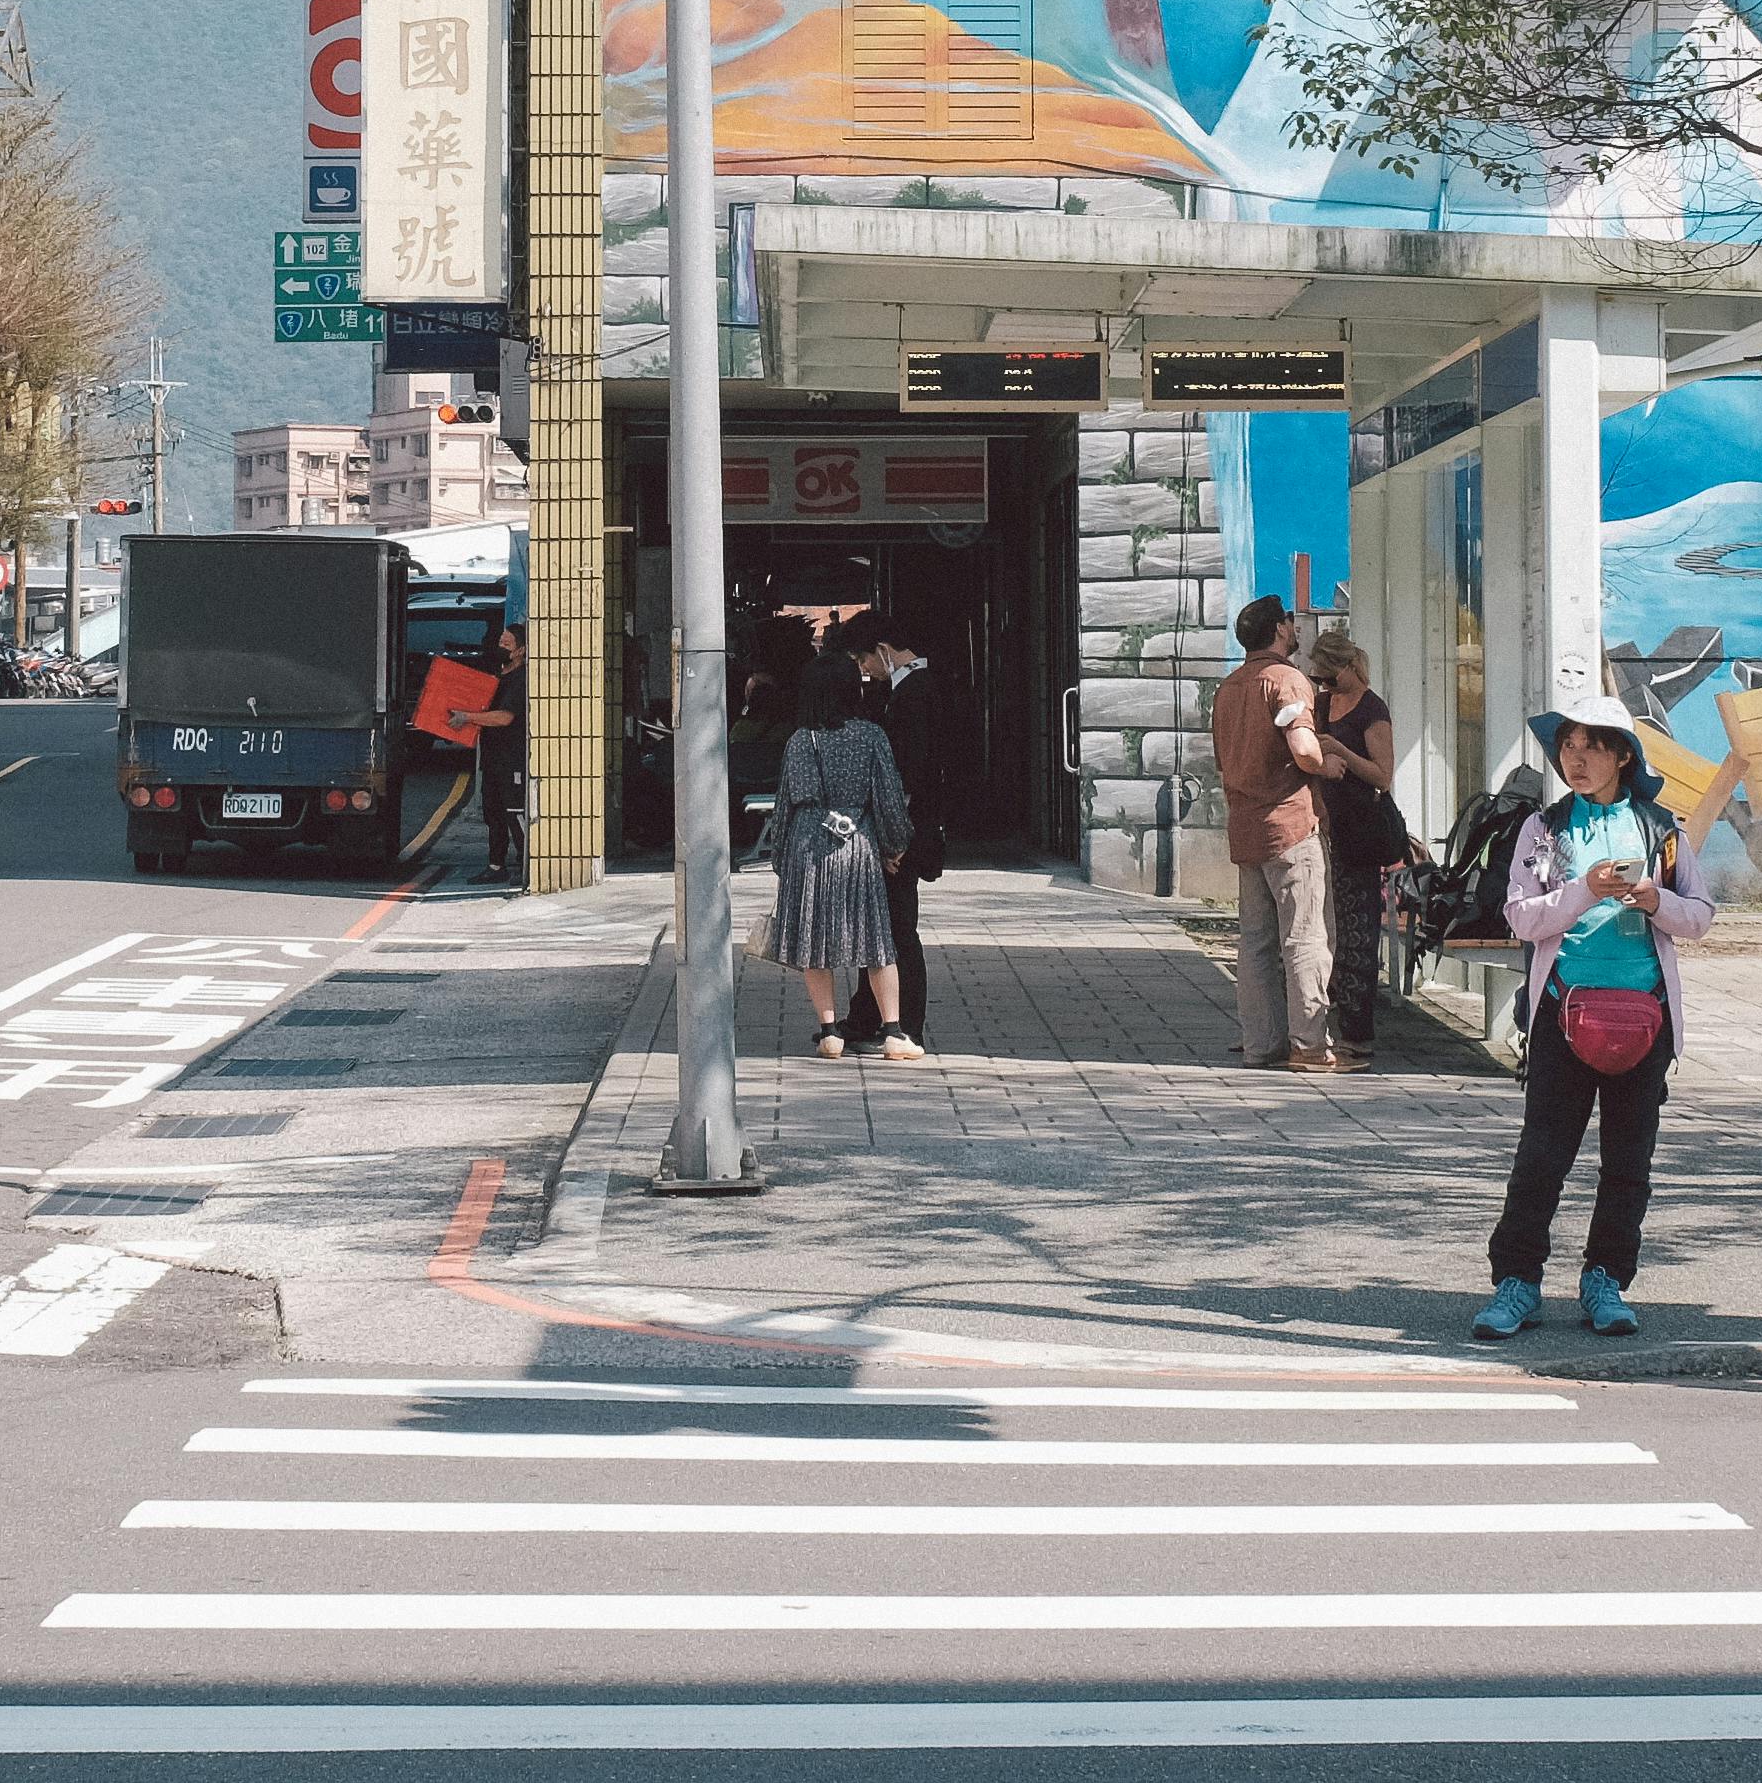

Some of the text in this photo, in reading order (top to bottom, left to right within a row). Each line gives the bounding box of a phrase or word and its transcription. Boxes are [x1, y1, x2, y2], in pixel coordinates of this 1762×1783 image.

[306, 244, 325, 256] 102
[332, 233, 361, 254] 金
[307, 308, 358, 329] 八堵
[323, 331, 349, 341] Badu
[794, 459, 861, 501] OK
[239, 730, 283, 755] 2110
